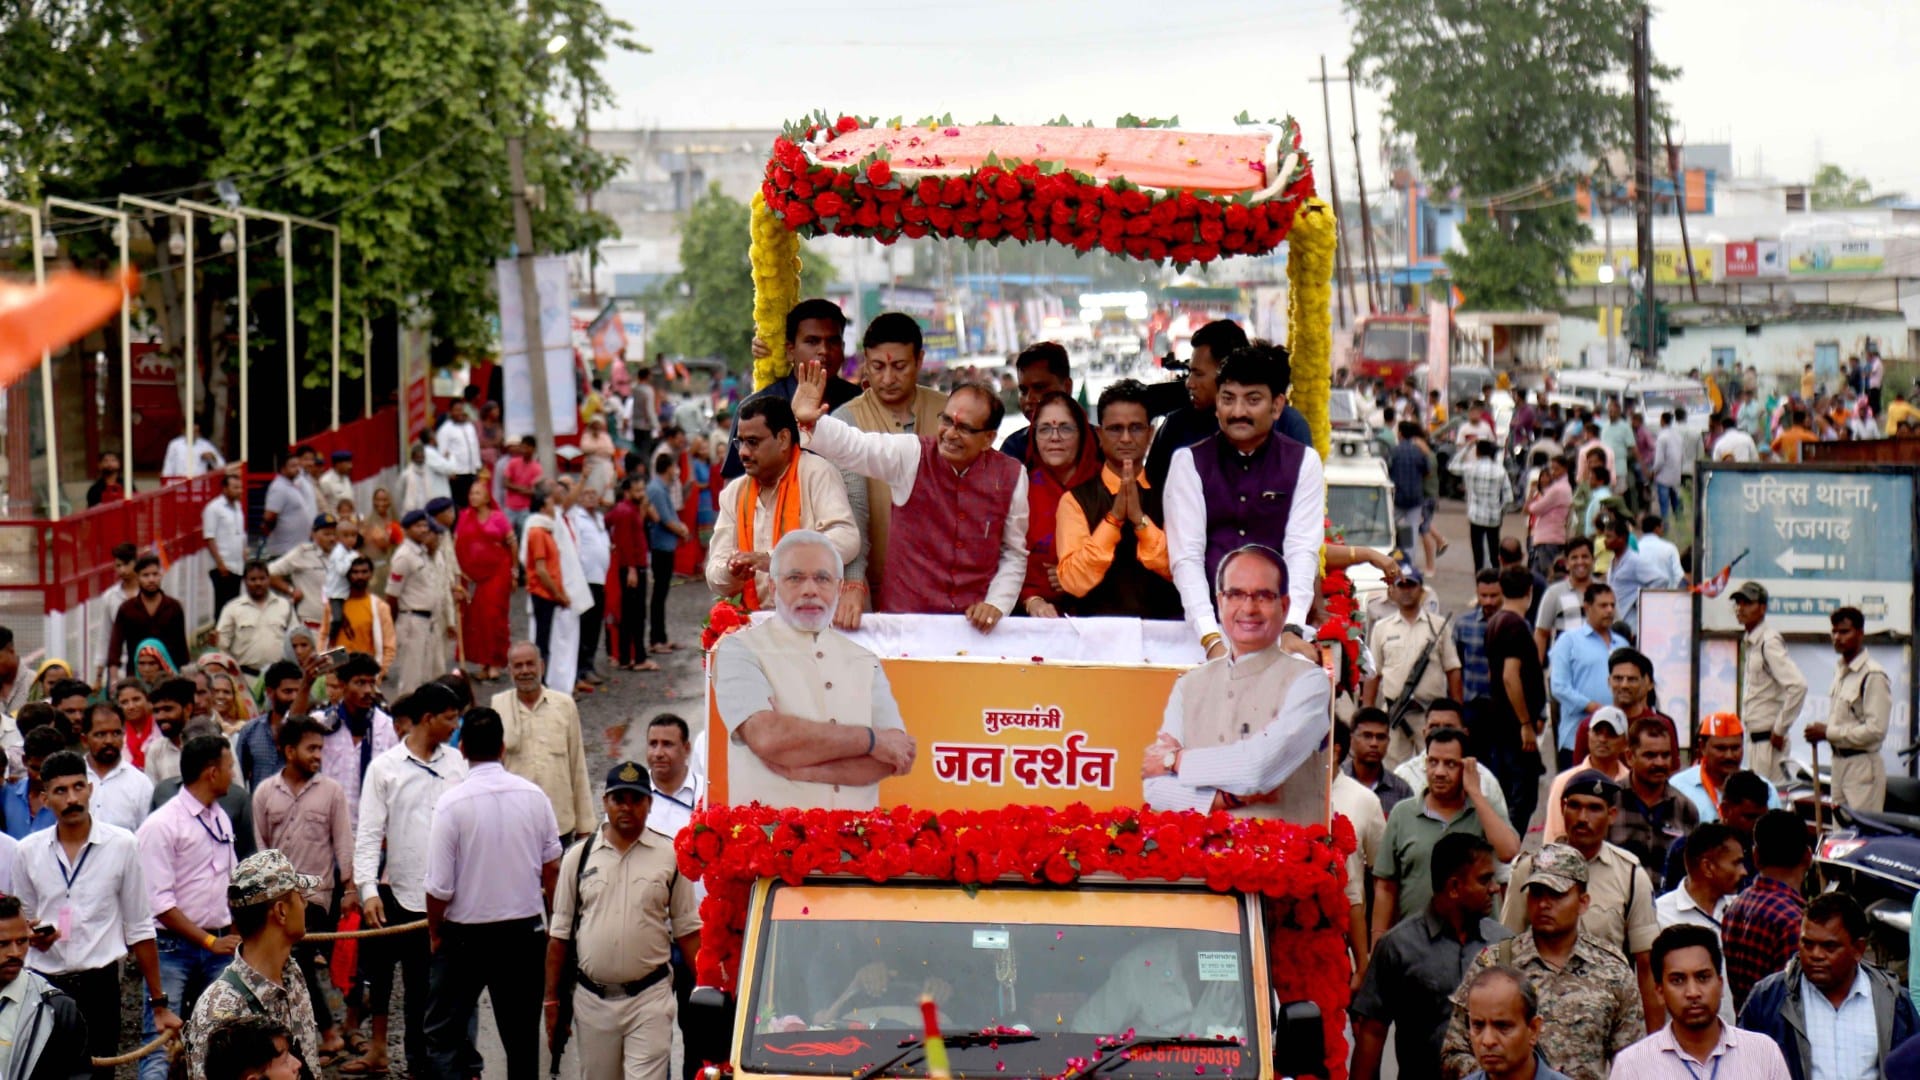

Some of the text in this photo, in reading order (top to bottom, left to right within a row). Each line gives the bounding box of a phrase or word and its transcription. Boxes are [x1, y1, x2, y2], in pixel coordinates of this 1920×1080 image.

[1743, 476, 1878, 512] पुलिस थाना,
[1774, 517, 1852, 544] राजगढ़
[984, 706, 1061, 732] मुख्यमंत्री
[935, 734, 1115, 788] जन दर्शन
